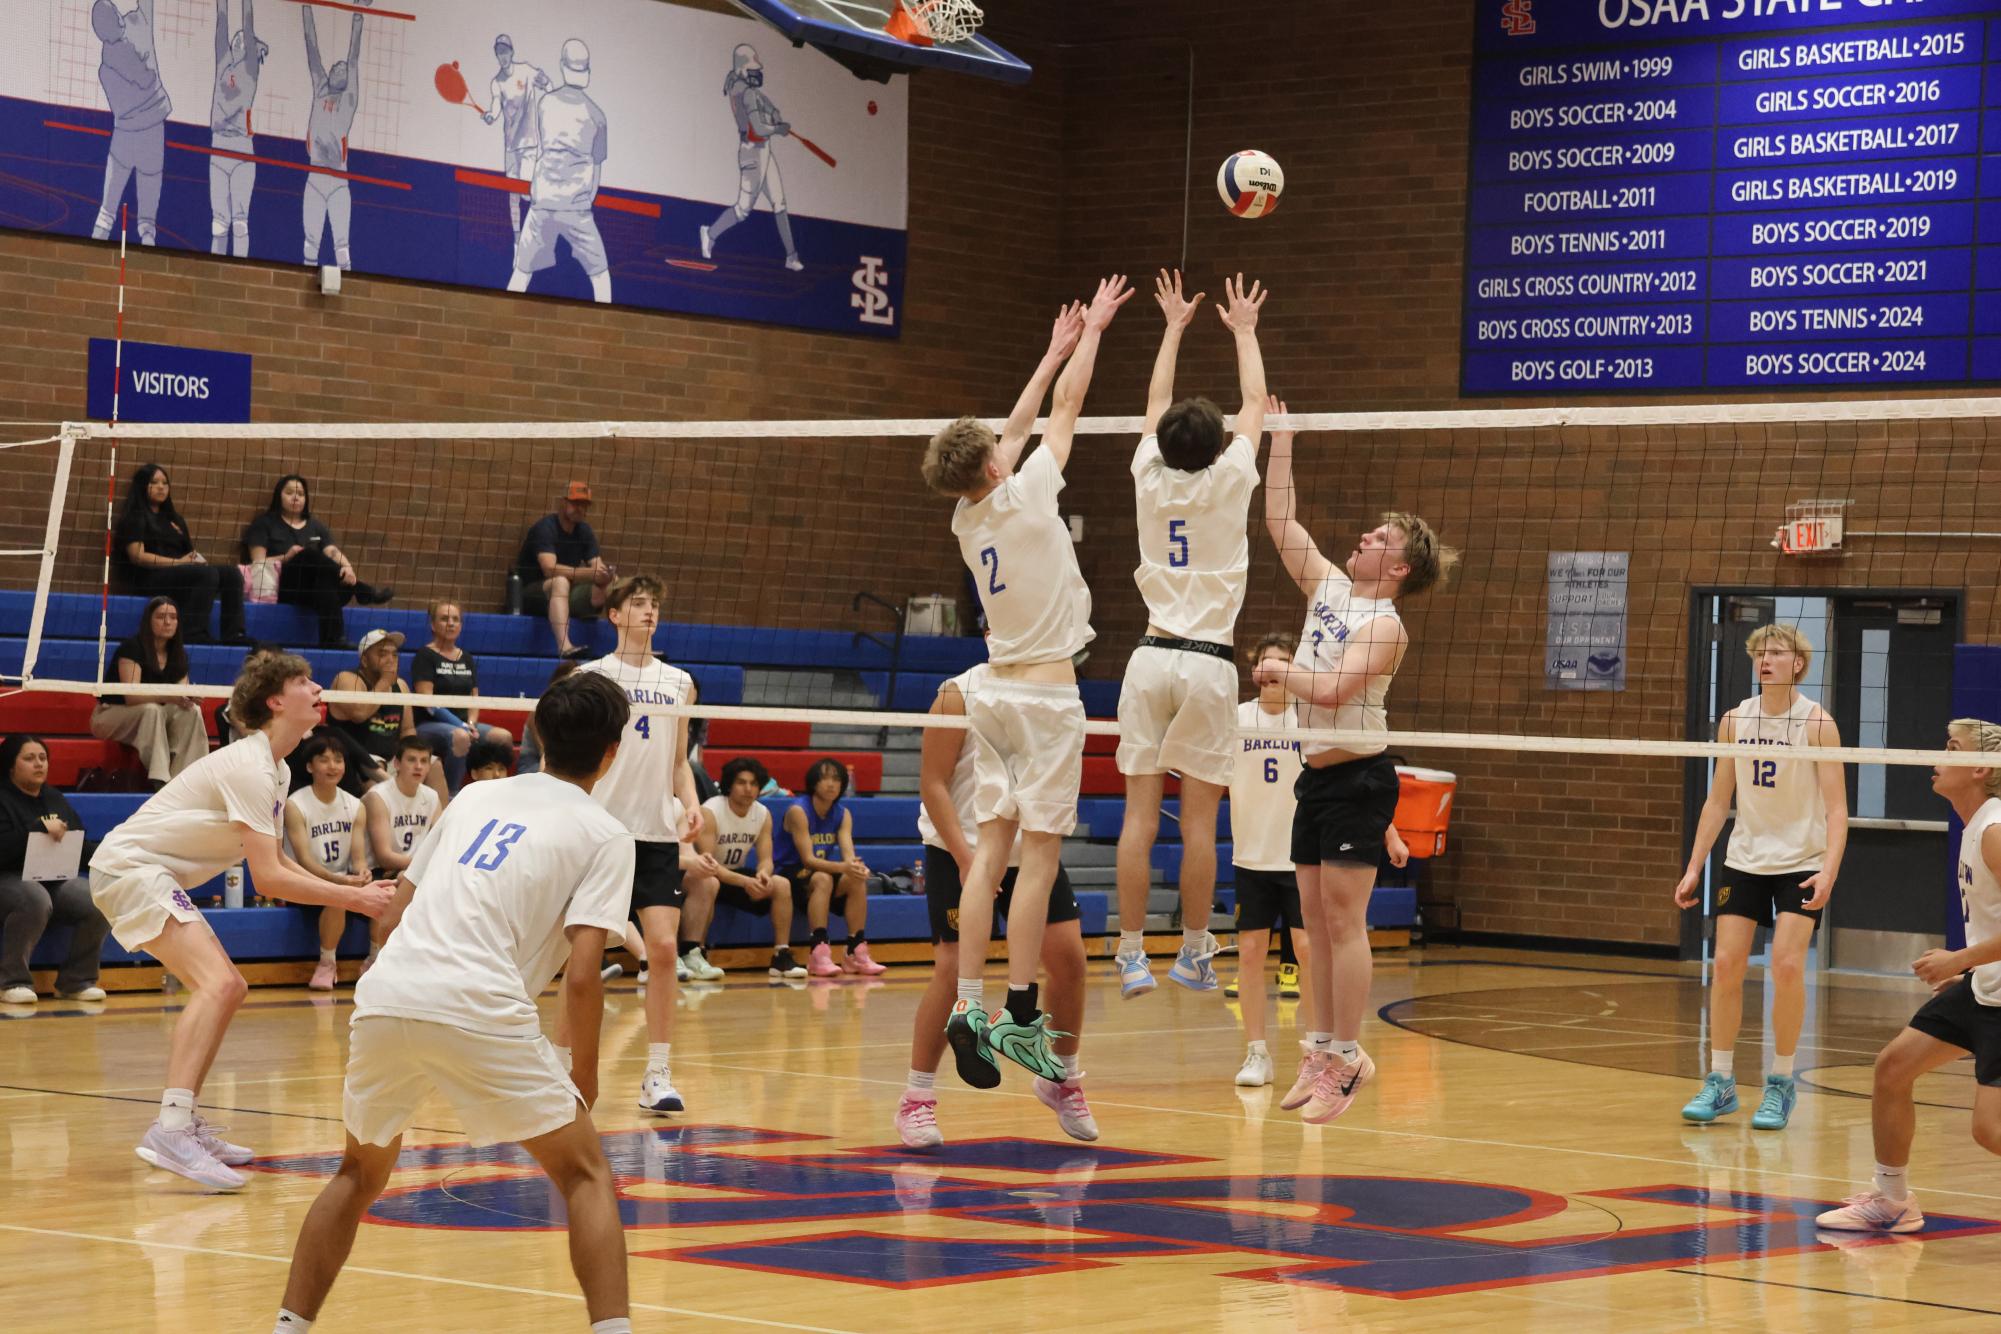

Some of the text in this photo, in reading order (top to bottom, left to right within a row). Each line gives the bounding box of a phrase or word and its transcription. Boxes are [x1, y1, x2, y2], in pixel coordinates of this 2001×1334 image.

[1739, 46, 1791, 71] GIRLS
[1519, 65, 1567, 86] GIRLS
[1755, 88, 1809, 114] GIRLS
[1510, 107, 1554, 130] BOYS
[1733, 134, 1786, 159] GIRLS
[1509, 149, 1553, 171] BOYS
[1248, 180, 1277, 192] Wilson
[1731, 178, 1784, 202] GIRLS
[1751, 221, 1800, 245] BOYS
[1511, 234, 1555, 256] BOYS
[1478, 277, 1521, 298] GIRLS
[1524, 275, 1574, 297] CROSS
[1750, 264, 1798, 288] BOYS
[1478, 319, 1518, 340] BOYS
[1521, 317, 1571, 339] CROSS
[1749, 309, 1798, 332] BOYS
[1511, 360, 1555, 381] BOYS
[1746, 354, 1795, 376] BOYS
[132, 370, 210, 399] VISITORS
[1169, 520, 1188, 567] 5
[1797, 522, 1825, 547] EXIT
[980, 547, 1006, 595] 2
[1587, 567, 1606, 577] FOR
[1608, 567, 1626, 577] OUR
[1181, 640, 1220, 655] NIKE
[624, 689, 675, 705] ARLOW
[634, 715, 650, 740] 4
[1243, 739, 1301, 753] BARLOW
[1264, 757, 1279, 784] 6
[1752, 759, 1777, 788] 12
[311, 820, 352, 839] BARLOW
[394, 814, 429, 828] BARLOW
[323, 840, 340, 864] 15
[403, 832, 414, 852] 9
[458, 818, 527, 871] 13
[724, 848, 743, 865] 10
